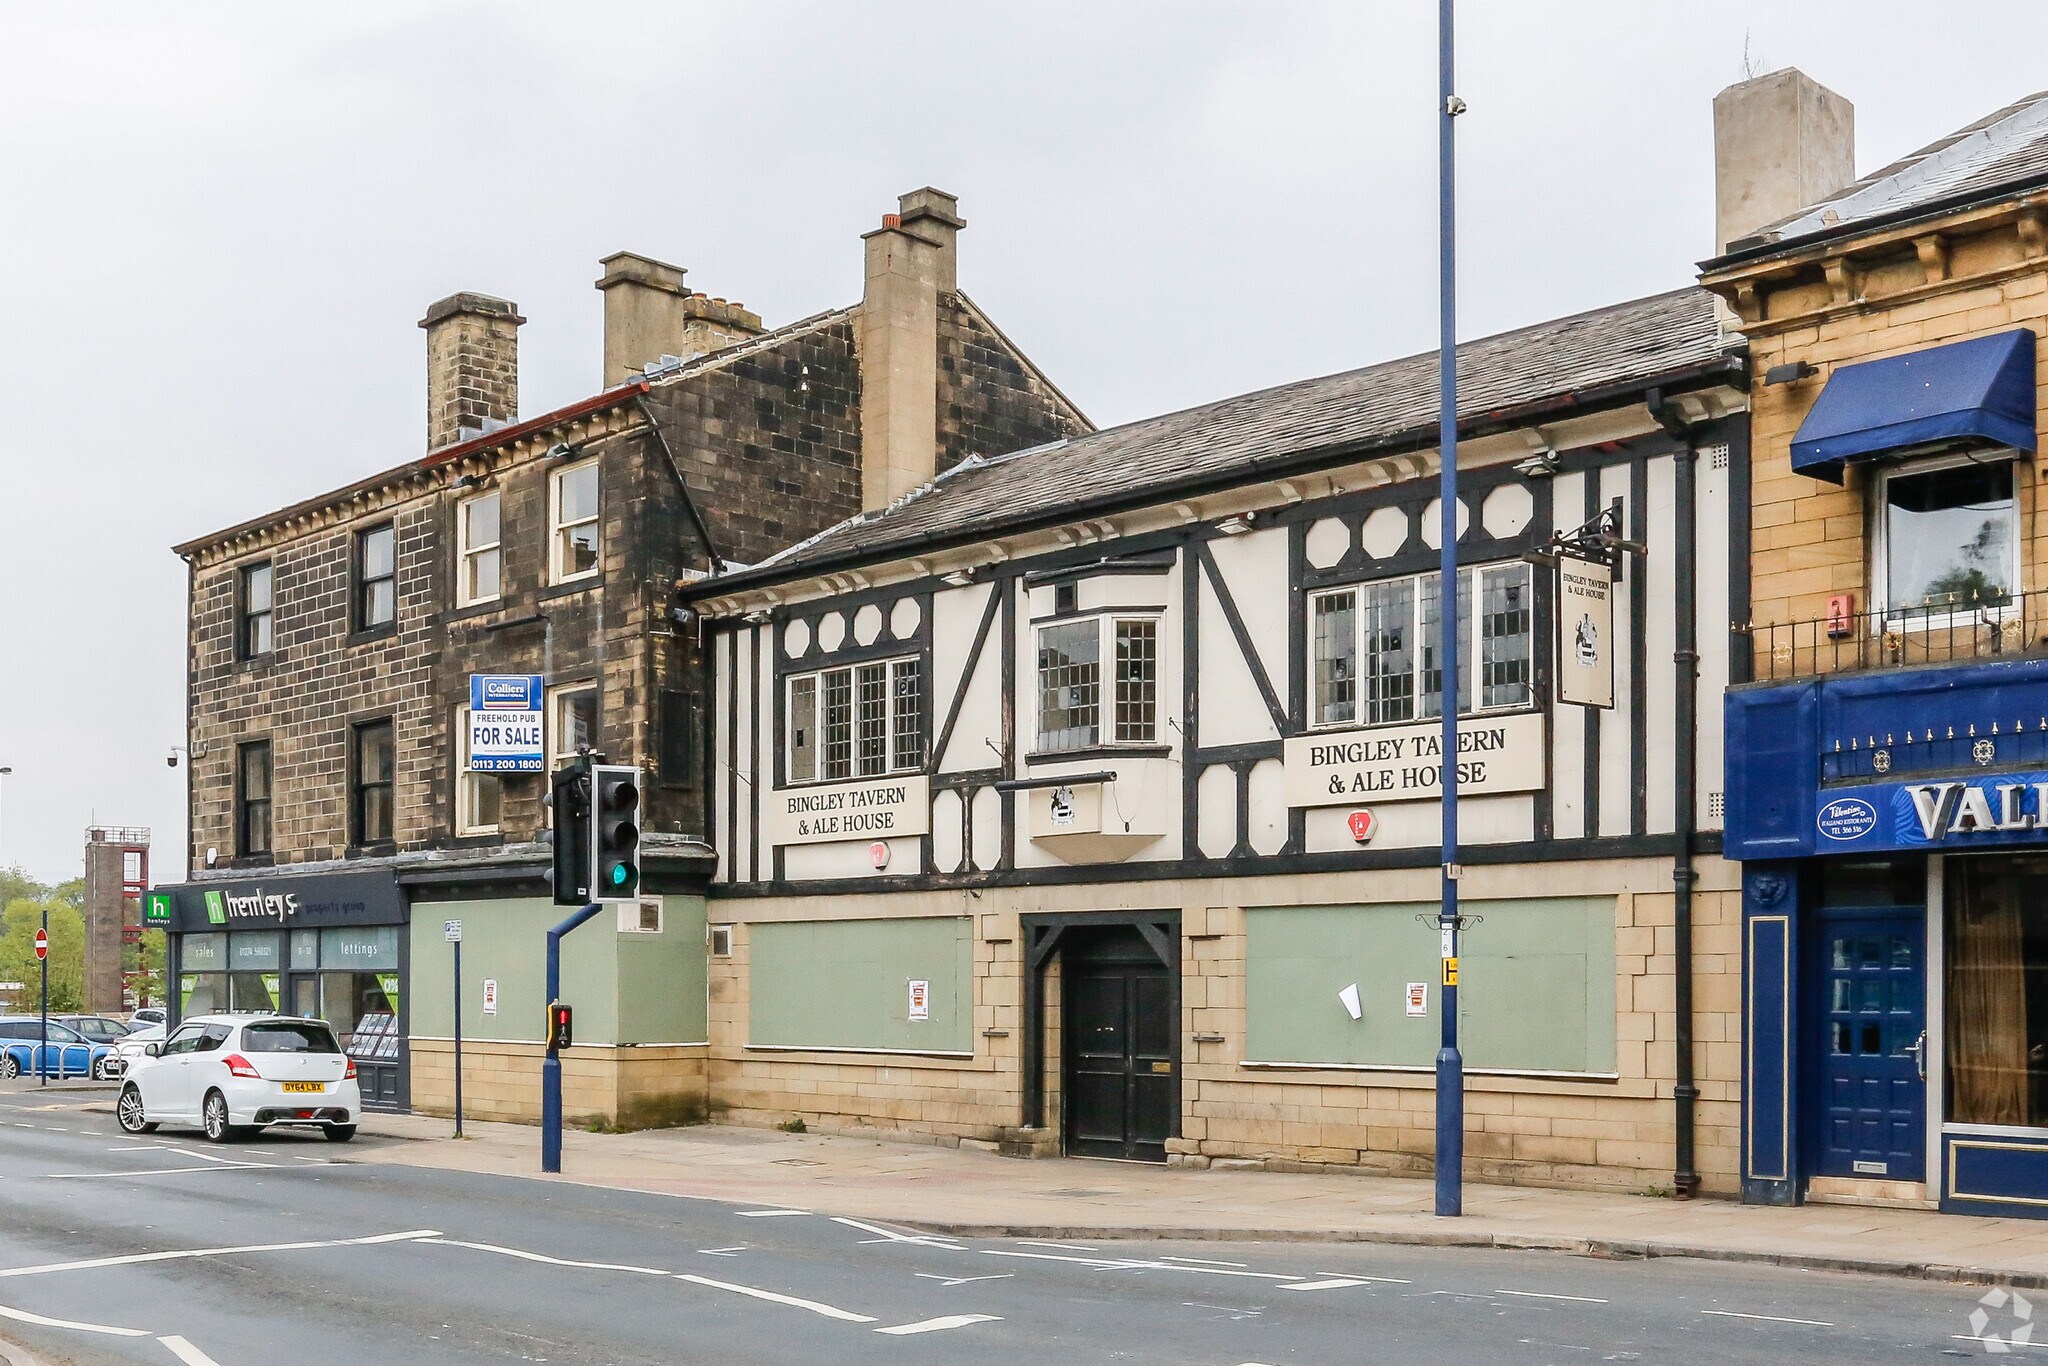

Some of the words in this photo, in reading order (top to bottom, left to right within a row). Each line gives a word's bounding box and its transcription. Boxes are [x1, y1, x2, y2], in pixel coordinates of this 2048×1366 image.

[1568, 585, 1572, 594] &
[1574, 586, 1584, 596] ALE
[488, 683, 524, 693] Colliers
[473, 727, 500, 745] FOR
[505, 727, 540, 745] SALE
[1310, 737, 1408, 767] BINGLEY
[1411, 728, 1506, 757] TAERN
[472, 760, 494, 769] 0113
[496, 760, 516, 769] 200
[518, 760, 542, 769] 1800
[1328, 774, 1345, 795] &
[1351, 769, 1395, 793] ALE
[787, 792, 846, 814] BINGLEY
[849, 786, 906, 808] TAVERN
[798, 819, 809, 836] &
[812, 817, 839, 834] ALE
[843, 811, 894, 832] HOUSE
[225, 887, 299, 923] henleys
[342, 901, 366, 914] group
[195, 945, 215, 958] sales
[341, 942, 378, 957] lettings
